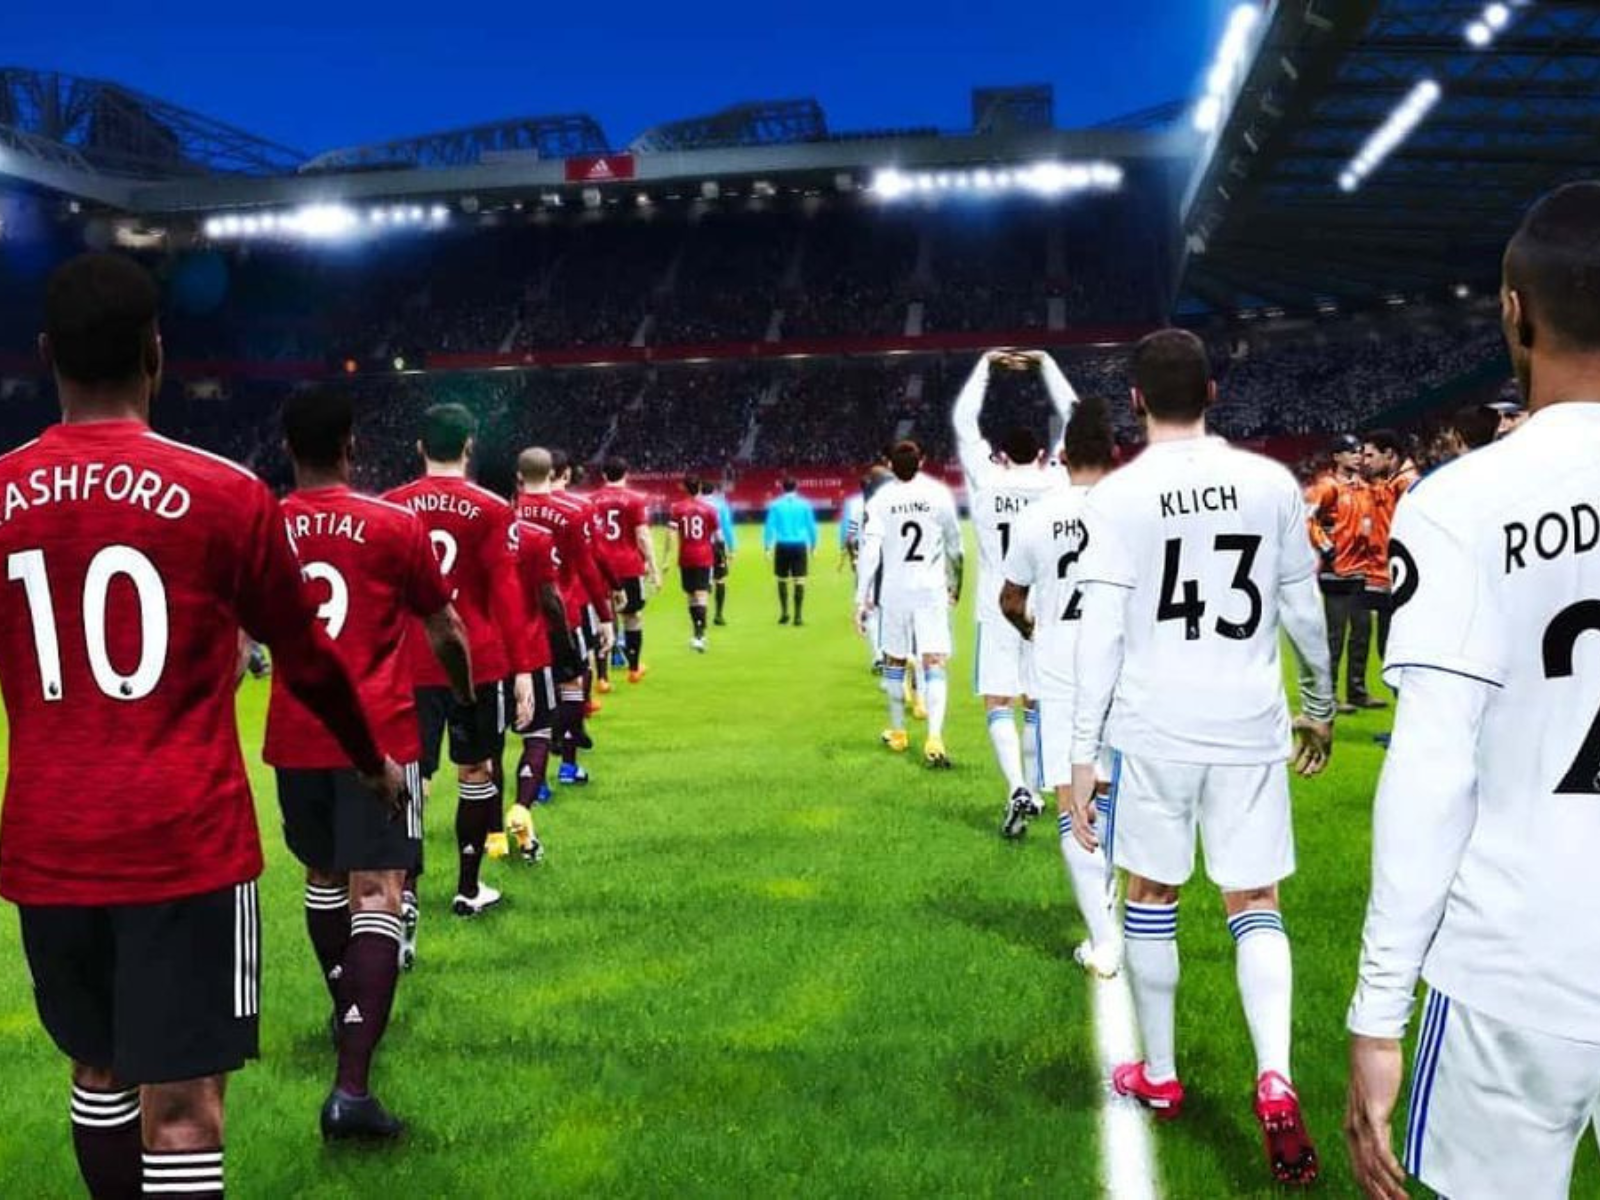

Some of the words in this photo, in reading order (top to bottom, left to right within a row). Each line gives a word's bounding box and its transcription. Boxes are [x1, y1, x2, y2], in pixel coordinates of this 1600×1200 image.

[0, 463, 191, 523] ASHFORD
[406, 494, 481, 519] INDELOF
[1160, 485, 1238, 518] KLICH
[294, 512, 366, 544] RTIAL
[606, 509, 620, 541] 5
[681, 515, 704, 540] 18
[901, 520, 924, 562] 2
[997, 522, 1010, 560] 1
[1053, 520, 1080, 540] PH
[1503, 503, 1600, 574] ROD
[1157, 533, 1262, 640] 43
[8, 545, 168, 701] 10
[1542, 599, 1600, 793] 2
